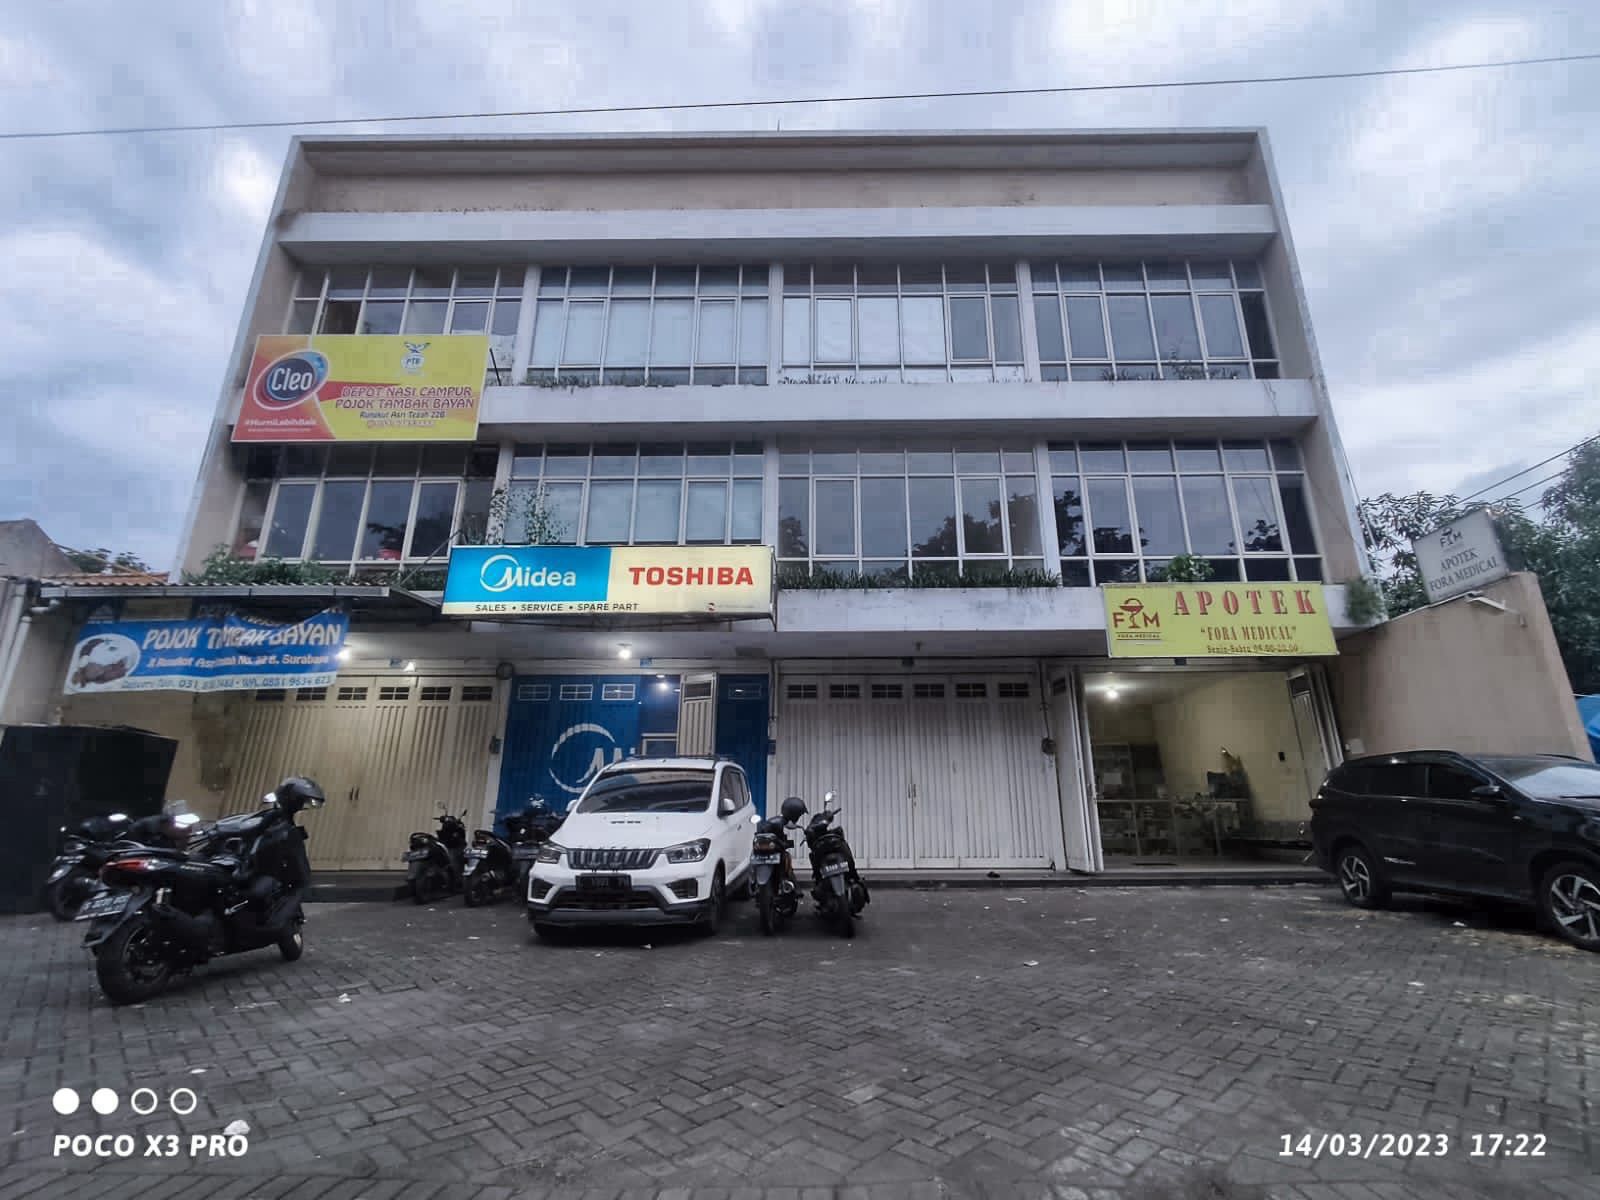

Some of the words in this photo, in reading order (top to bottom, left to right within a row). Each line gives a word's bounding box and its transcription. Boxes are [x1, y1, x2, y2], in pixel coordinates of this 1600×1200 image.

[271, 367, 313, 391] Cleo
[341, 386, 384, 397] DEPOT
[386, 386, 416, 397] NASI
[419, 386, 473, 397] CAMPUR
[335, 398, 374, 409] POJOK
[378, 398, 430, 409] TAMBAK
[433, 398, 474, 409] BAYAN
[1440, 547, 1478, 571] APOTEK
[492, 566, 577, 589] Midea
[628, 566, 754, 586] TOSHIBA
[1429, 574, 1455, 593] FORA
[1454, 556, 1498, 581] MEDICAL
[475, 603, 507, 612] SALES
[520, 603, 563, 612] SERVICE
[577, 603, 609, 611] SPARE
[612, 602, 639, 611] PART
[1173, 590, 1316, 616] APOTEK
[142, 626, 202, 650] POJOK
